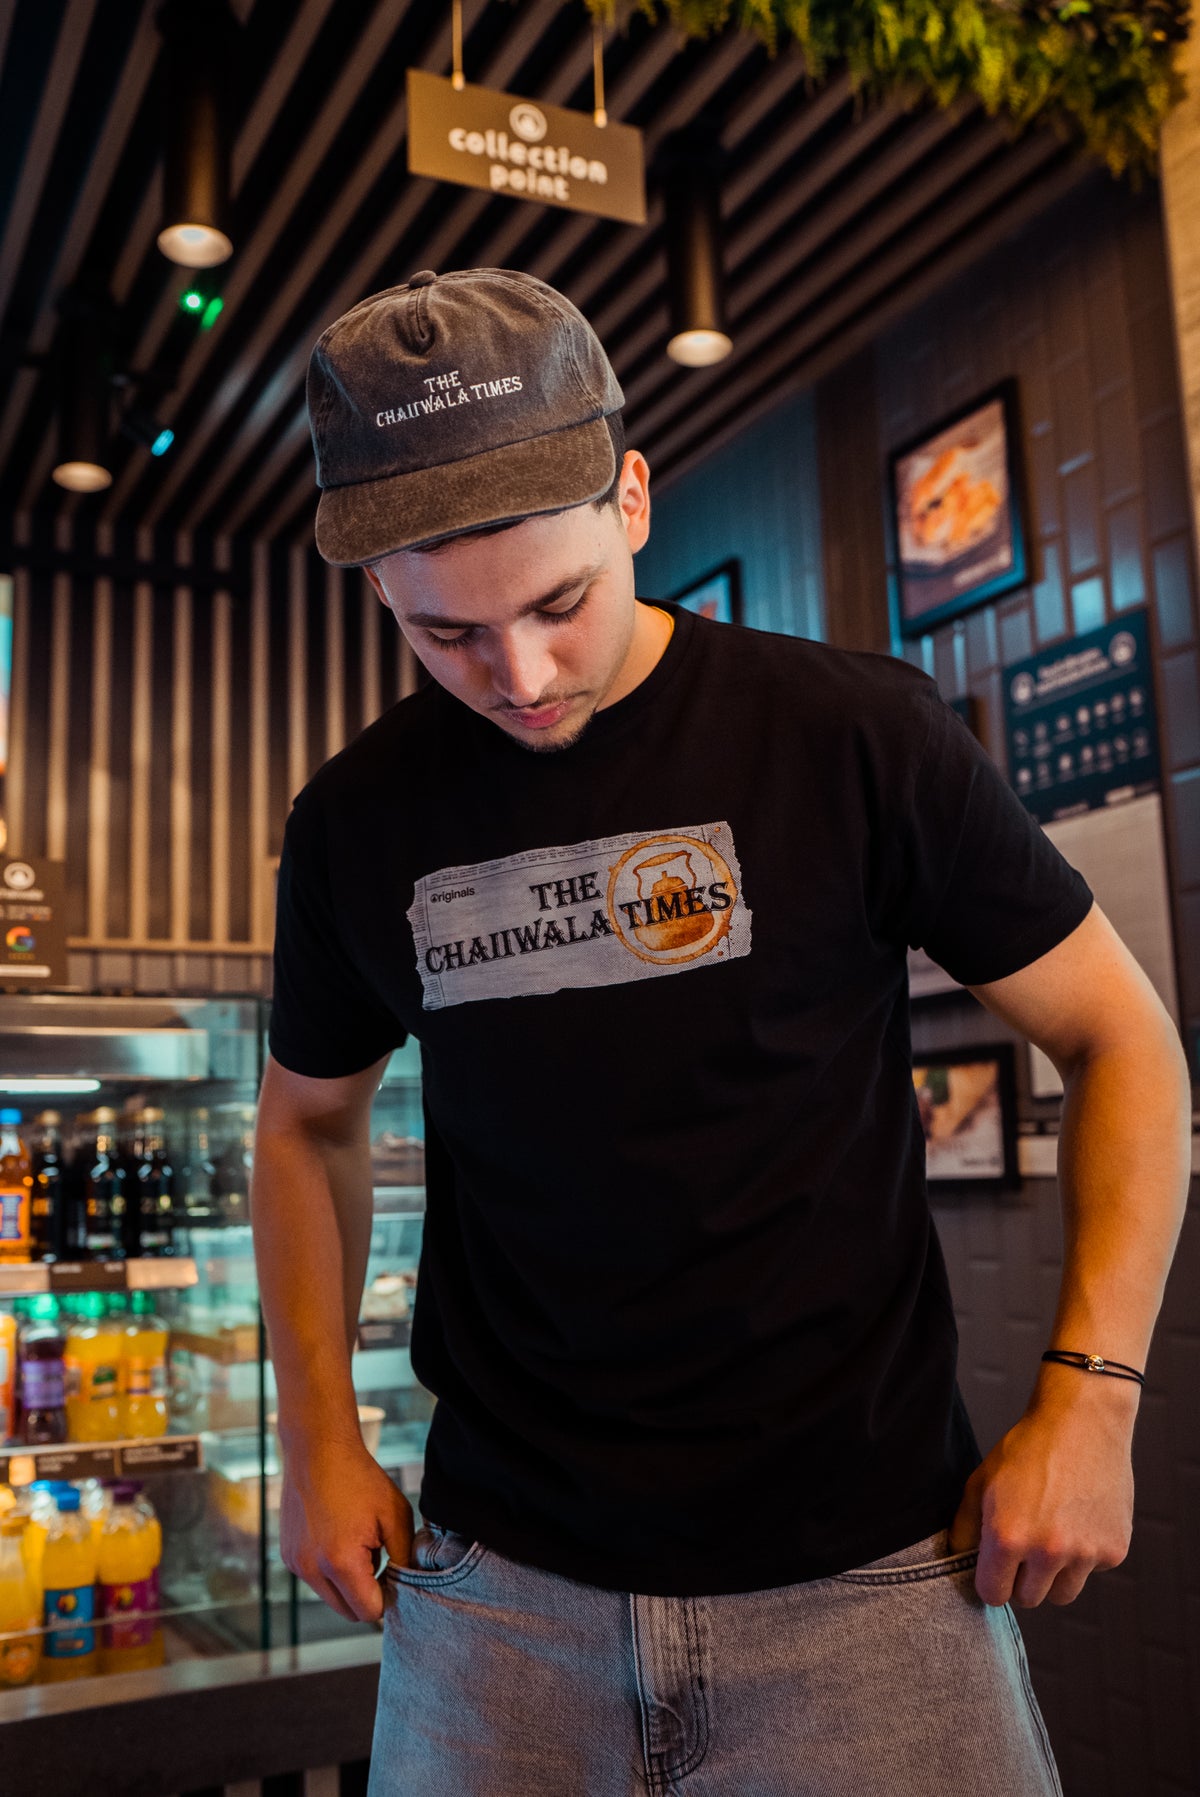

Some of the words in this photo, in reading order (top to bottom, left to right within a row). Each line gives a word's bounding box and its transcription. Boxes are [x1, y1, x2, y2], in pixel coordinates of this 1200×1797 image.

[448, 127, 608, 185] collection
[489, 163, 570, 202] point
[375, 388, 471, 428] CHAIIWALA
[469, 375, 523, 400] TIMES
[423, 370, 462, 394] THE
[529, 871, 605, 912] THE
[425, 909, 615, 974] CHAIIWALA
[618, 881, 734, 930] TIMES
